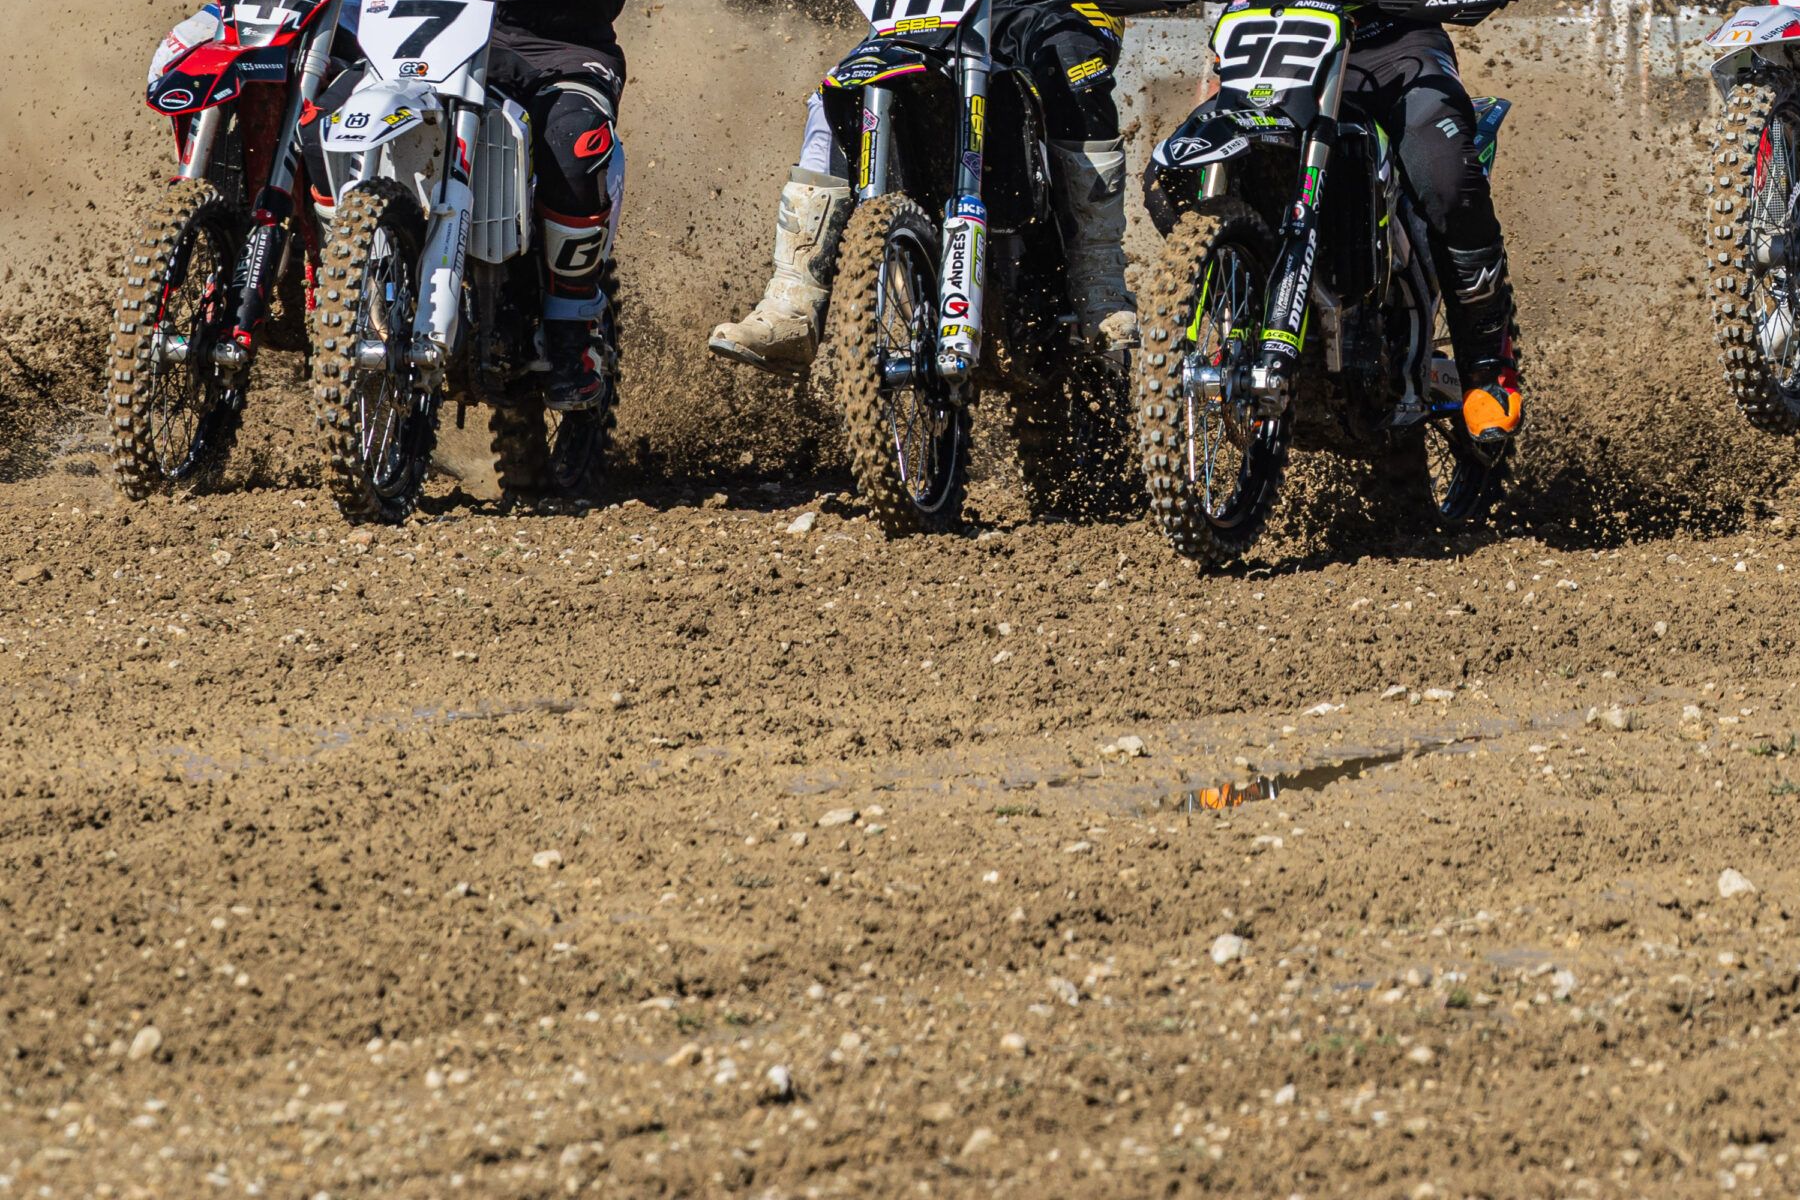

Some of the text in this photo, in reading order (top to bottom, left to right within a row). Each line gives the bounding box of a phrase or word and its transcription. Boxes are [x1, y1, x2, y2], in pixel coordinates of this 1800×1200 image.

[388, 0, 469, 59] 7
[894, 15, 942, 33] SB2
[1294, 0, 1337, 11] ANDER
[1220, 19, 1332, 82] 92
[1251, 89, 1272, 97] TEAM
[251, 233, 268, 289] GRENADIER
[952, 233, 967, 290] ANDRES
[1288, 228, 1317, 332] DUNLOP
